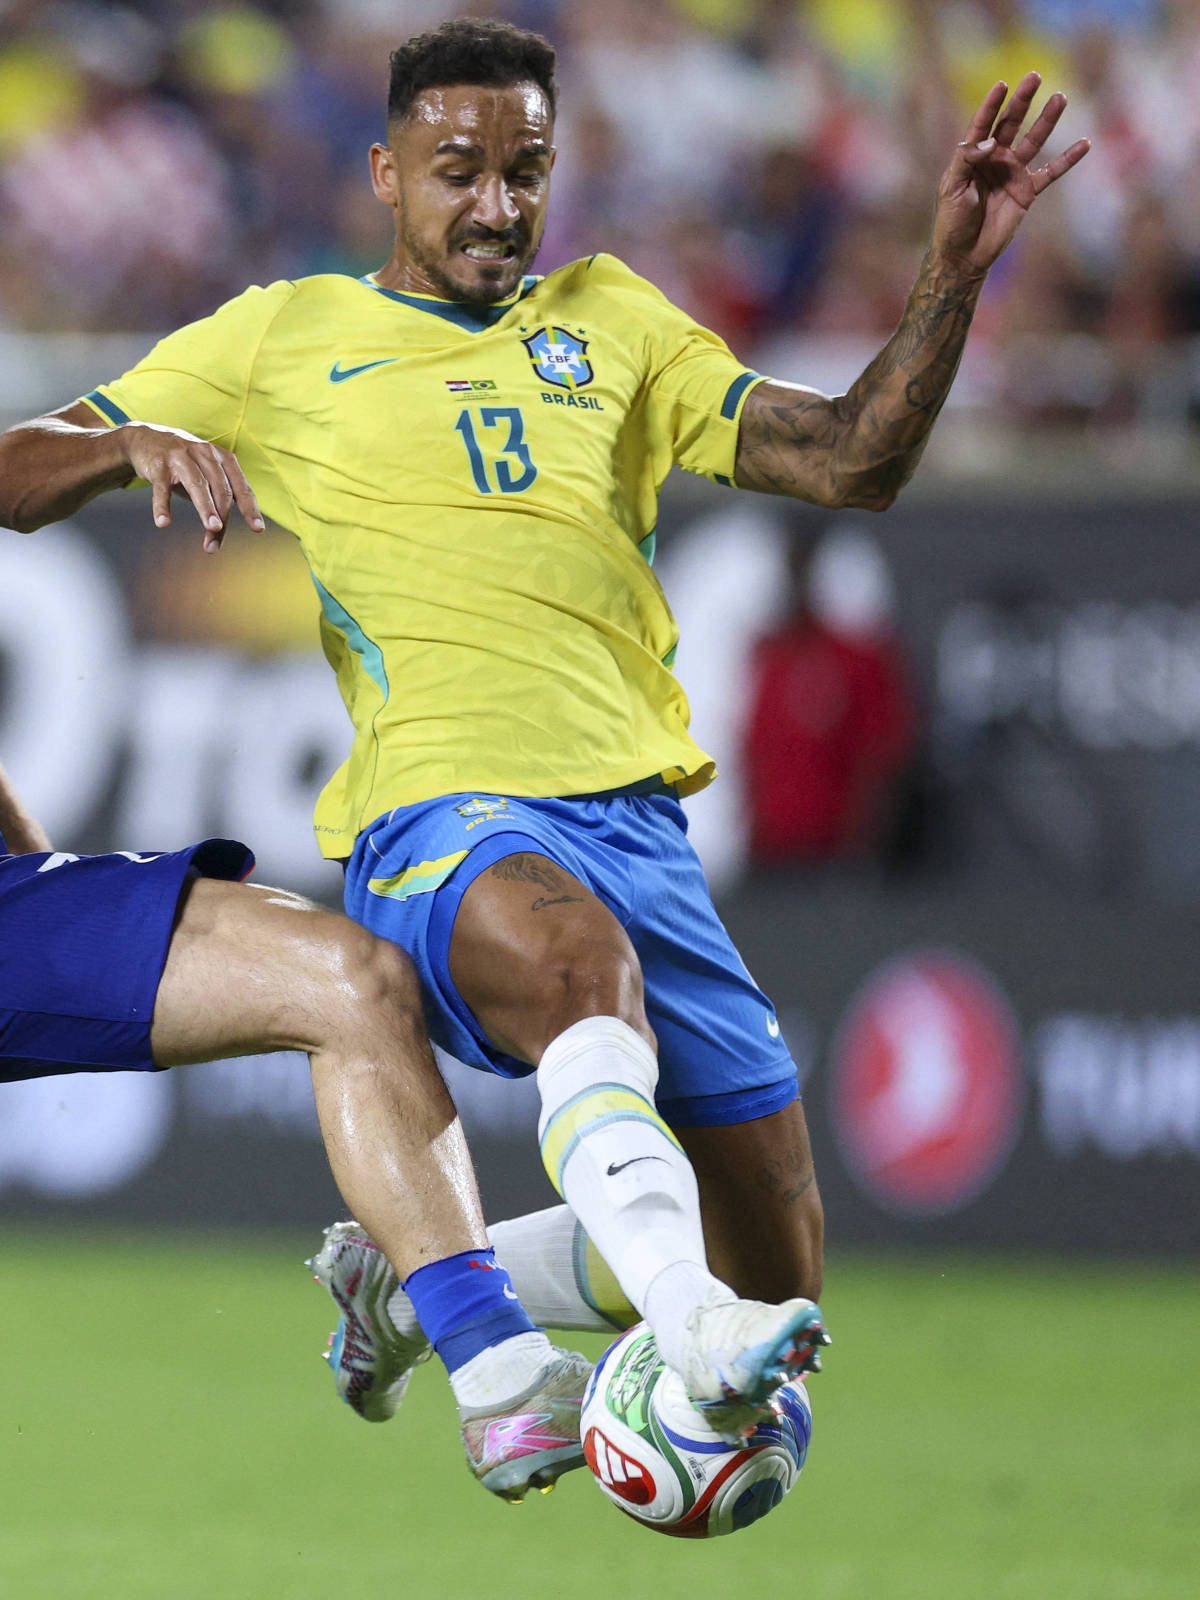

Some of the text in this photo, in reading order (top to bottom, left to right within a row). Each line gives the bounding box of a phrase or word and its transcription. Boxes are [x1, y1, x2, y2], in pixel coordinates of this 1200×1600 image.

[547, 355, 571, 364] CBF
[541, 392, 604, 411] BRASIL
[454, 407, 538, 494] 13
